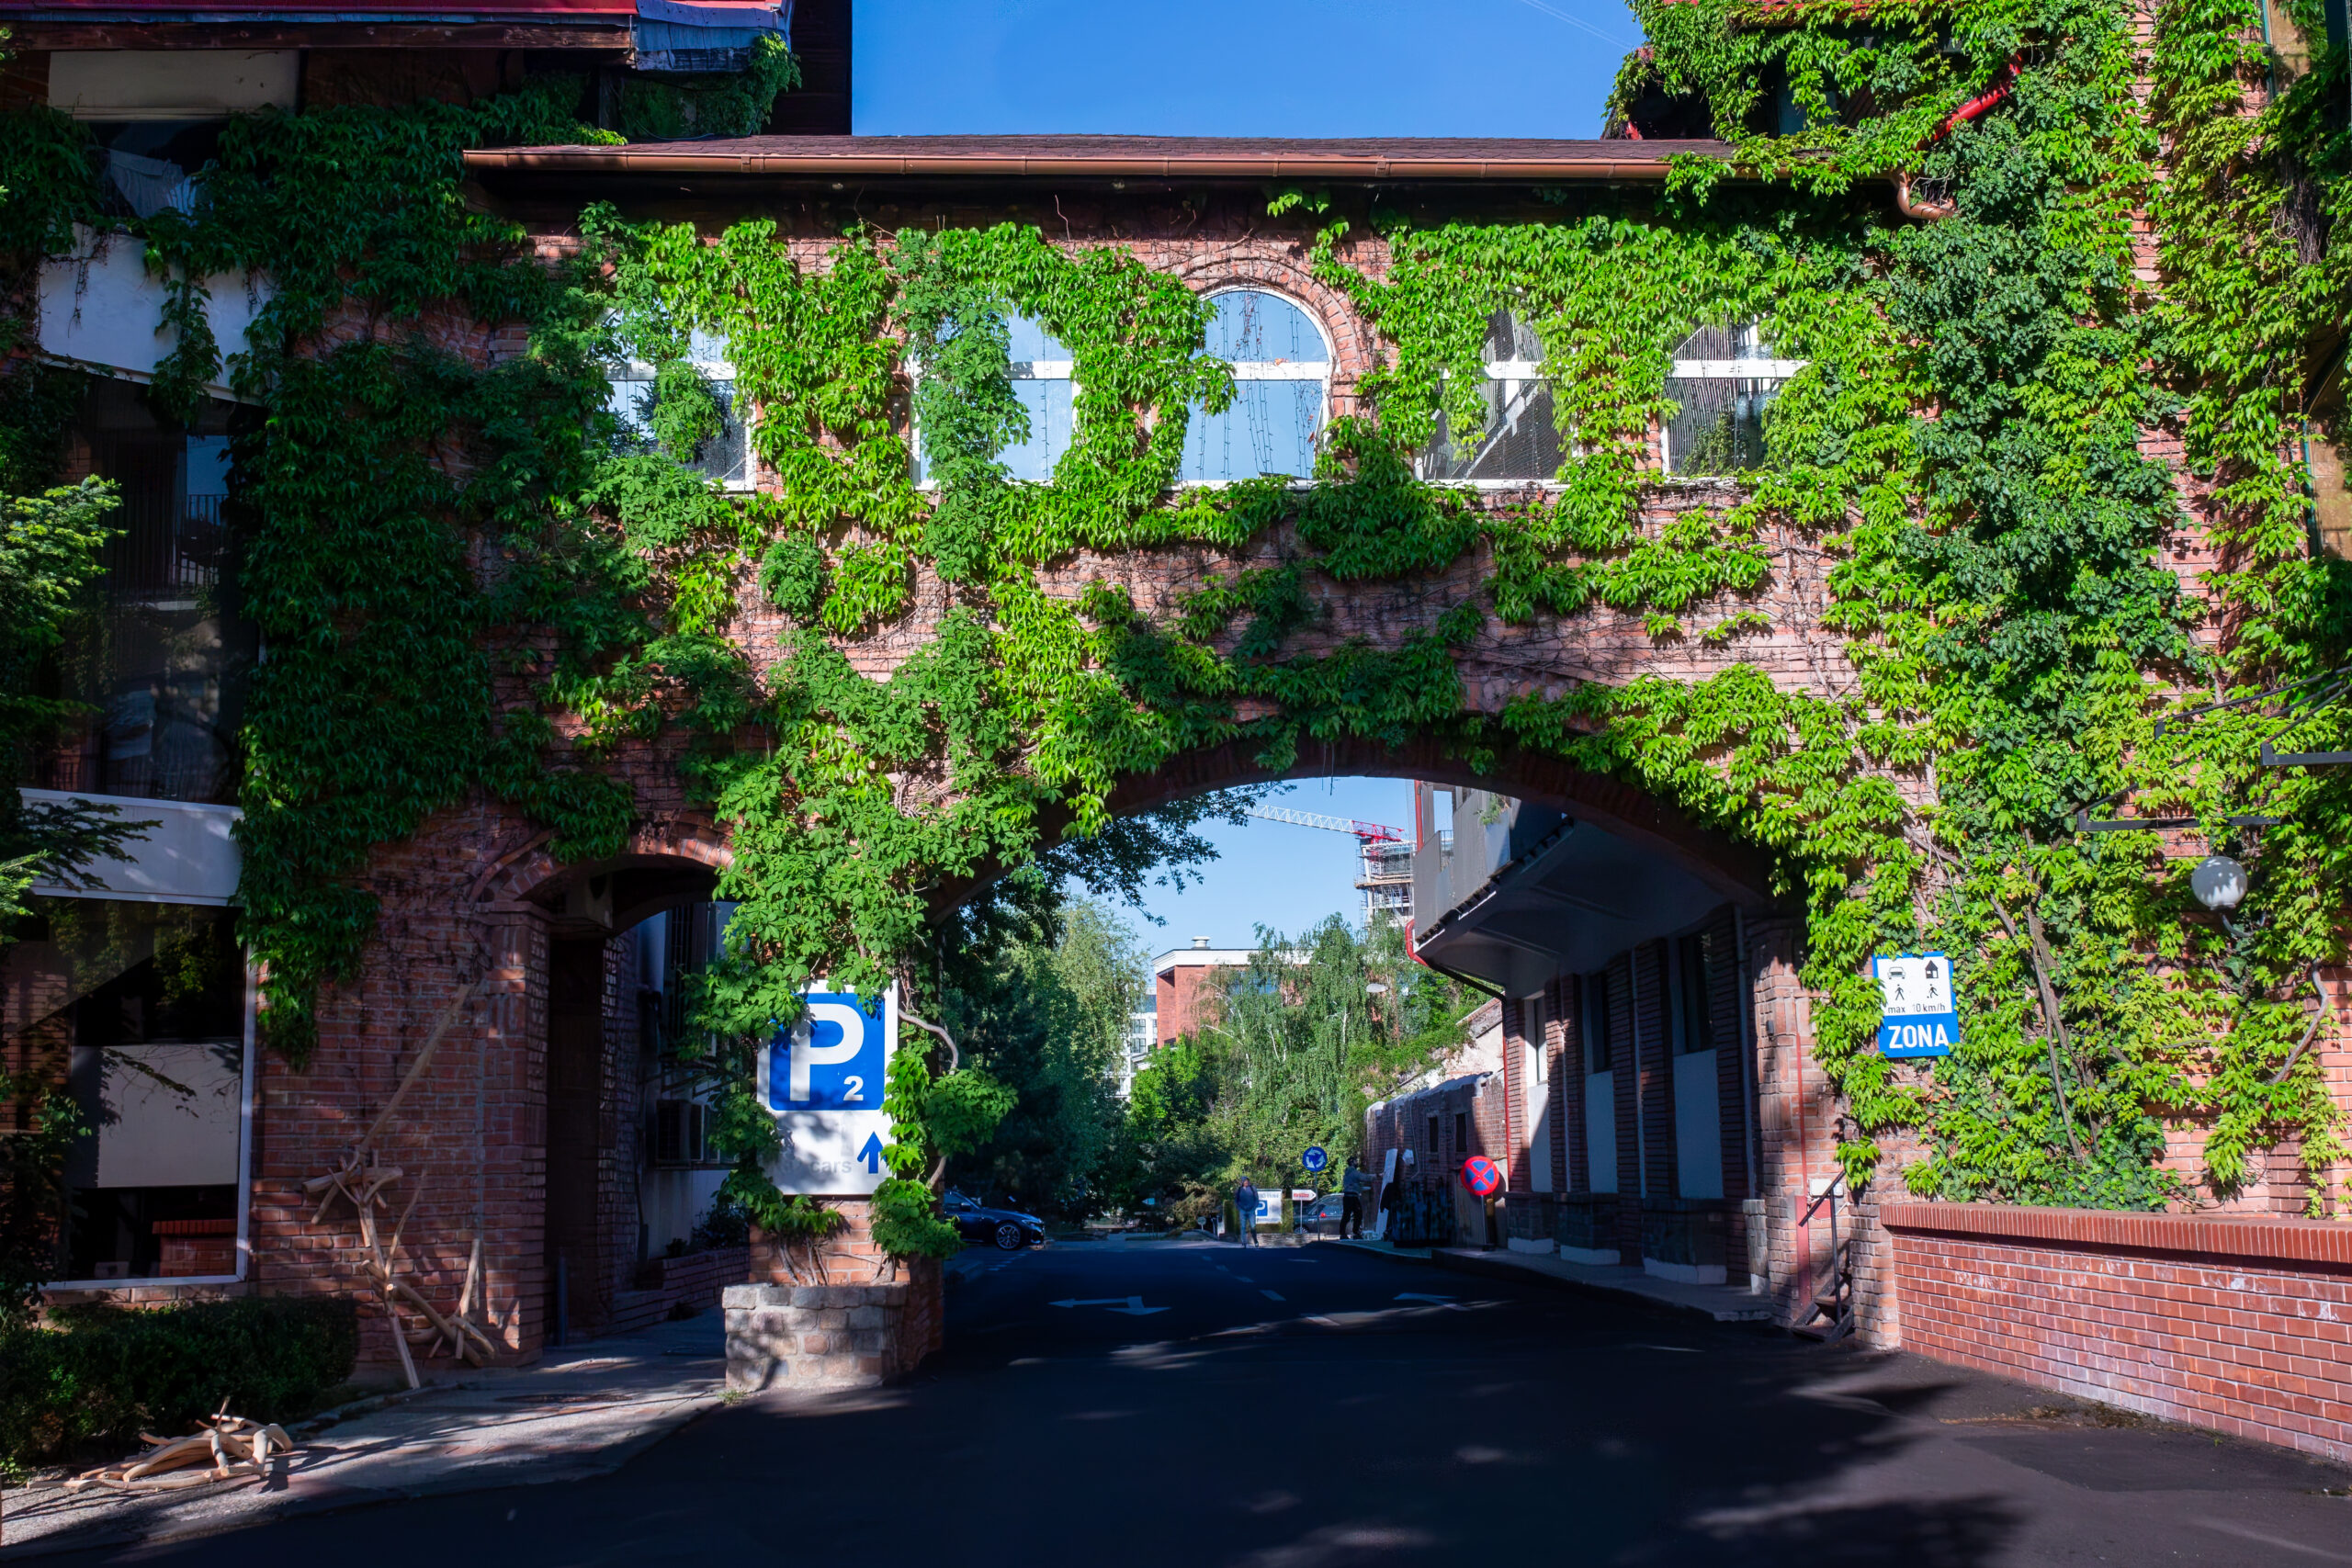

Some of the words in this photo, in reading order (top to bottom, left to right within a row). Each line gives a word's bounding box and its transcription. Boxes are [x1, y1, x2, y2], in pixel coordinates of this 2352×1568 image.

[1887, 1023, 1950, 1049] ZONA
[790, 1003, 864, 1101] P
[842, 1075, 864, 1101] 2
[809, 1160, 853, 1174] cars
